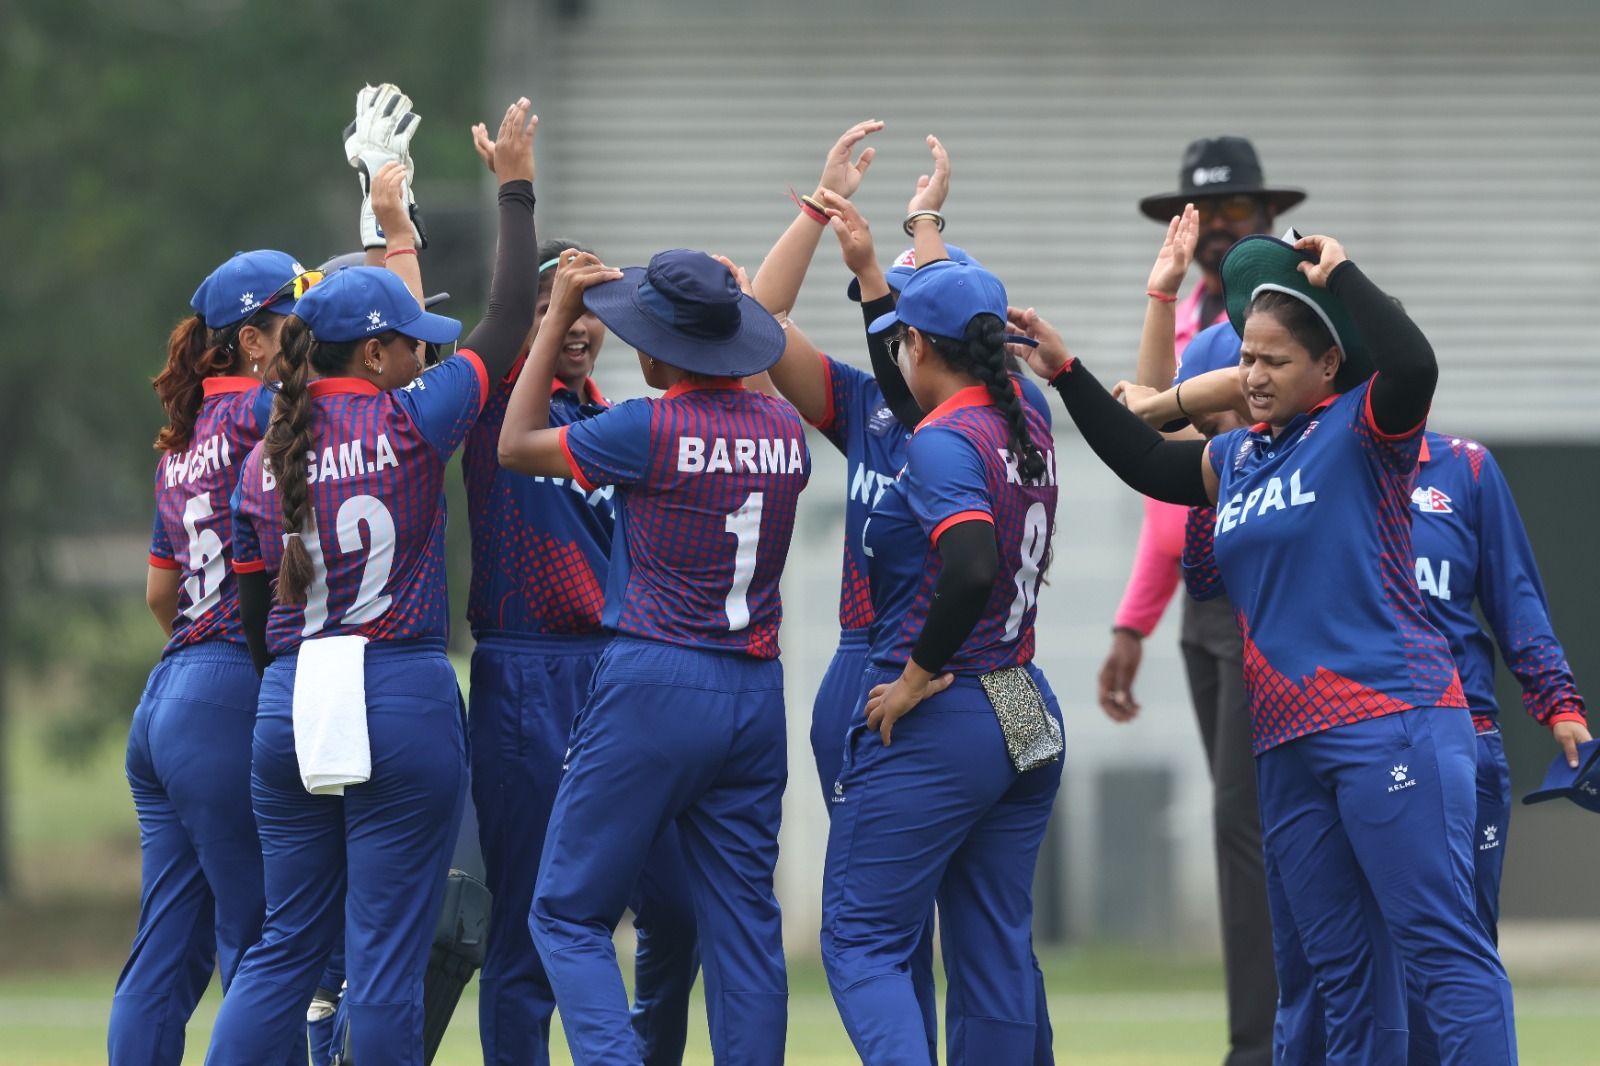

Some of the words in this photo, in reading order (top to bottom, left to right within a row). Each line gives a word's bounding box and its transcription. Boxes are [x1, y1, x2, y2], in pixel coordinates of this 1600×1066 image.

[366, 320, 388, 332] KELME
[262, 433, 399, 492] BGAM.A
[677, 436, 803, 474] BARMA
[282, 494, 396, 637] 12
[725, 492, 764, 631] 1
[1000, 502, 1047, 642] 8
[1388, 779, 1416, 793] KELME
[1479, 840, 1500, 851] KELME
